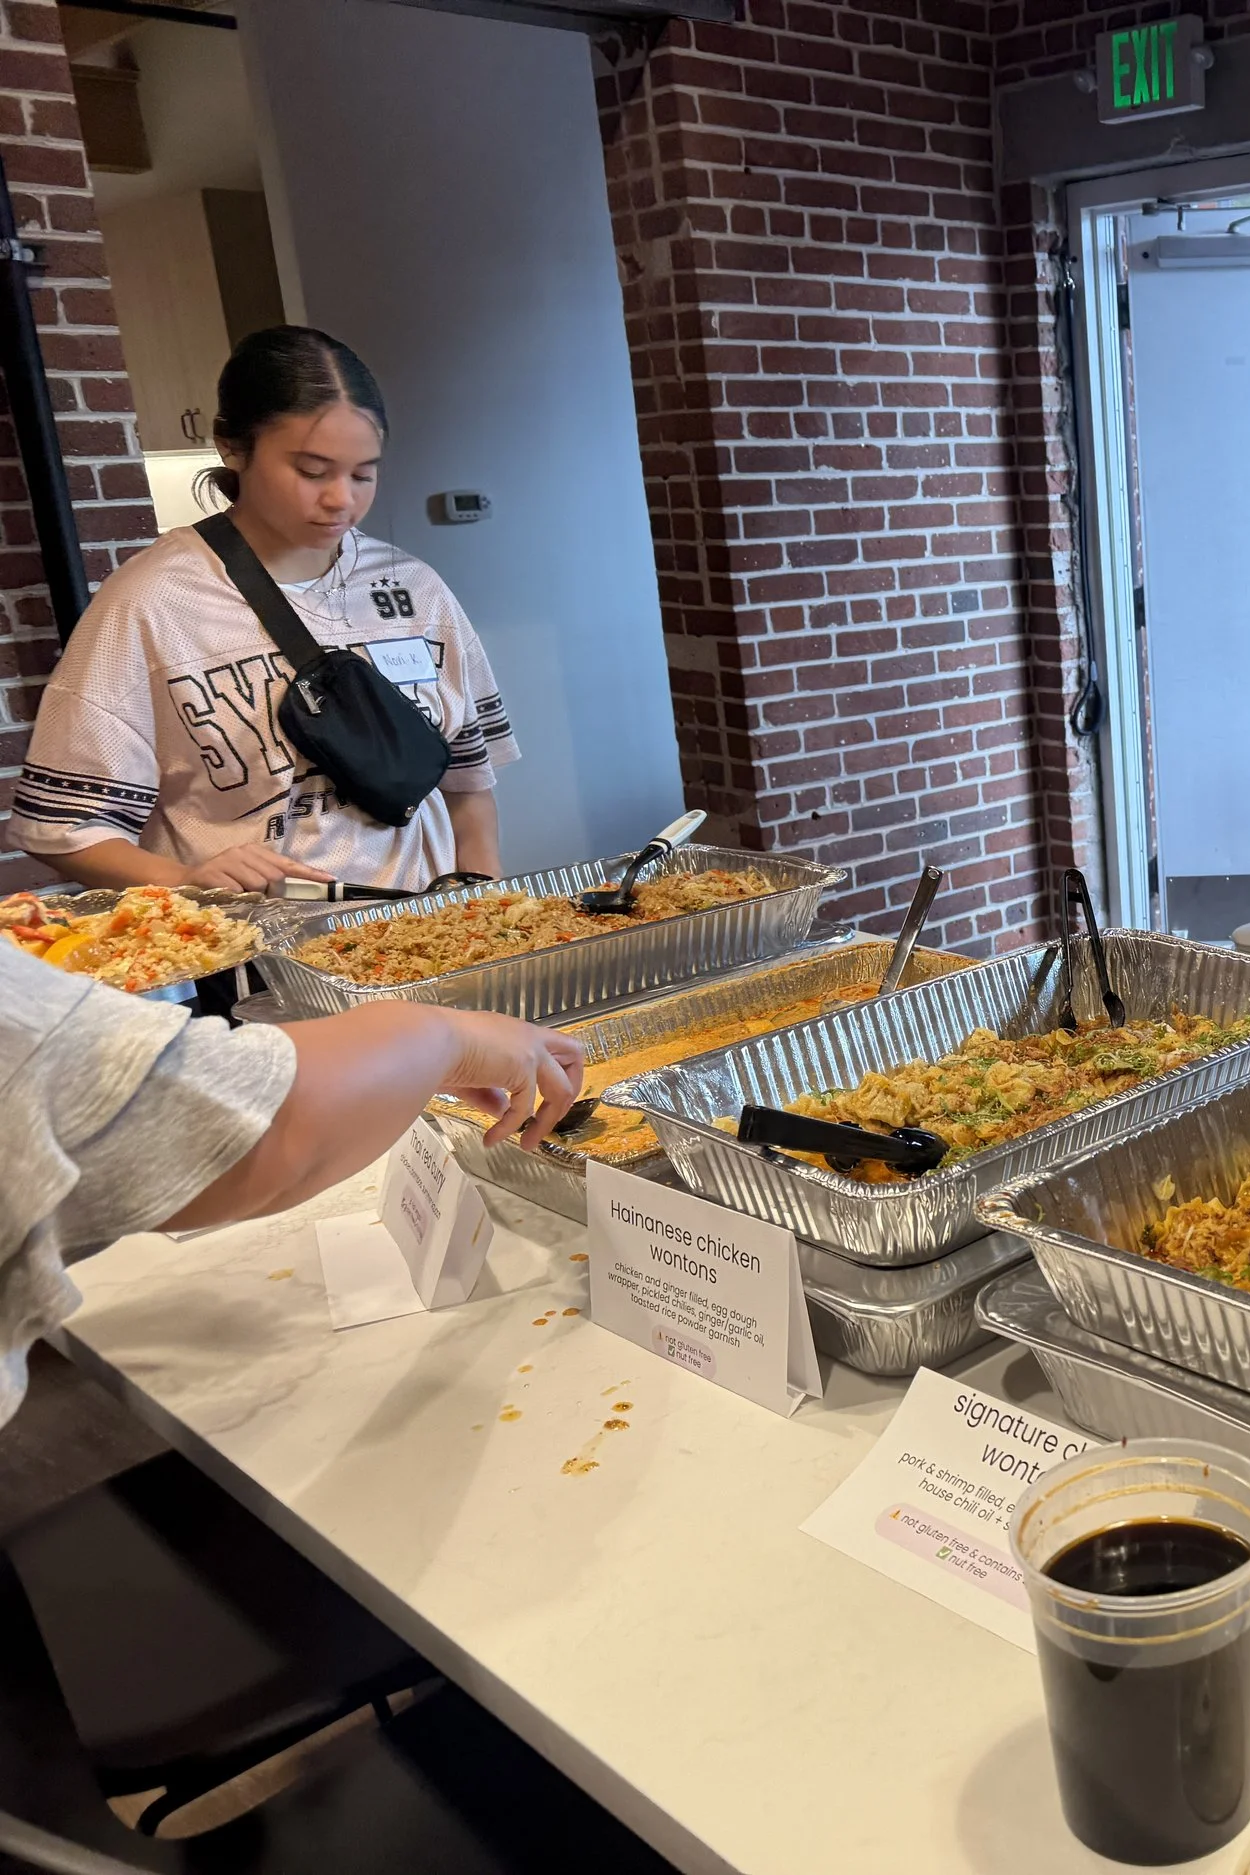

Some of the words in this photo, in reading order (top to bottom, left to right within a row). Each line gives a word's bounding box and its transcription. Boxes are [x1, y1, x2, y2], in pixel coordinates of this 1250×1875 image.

[1112, 21, 1178, 108] EXIT
[370, 588, 416, 621] 98
[421, 1149, 434, 1171] red
[431, 1161, 446, 1195] curry
[611, 1200, 692, 1246] Hainanese
[697, 1234, 761, 1274] chicken
[650, 1244, 718, 1284] wontons
[607, 1271, 641, 1294] wrapper,
[641, 1285, 670, 1304] pickled
[698, 1310, 753, 1341] ginger/garlic
[753, 1333, 766, 1348] oil,
[614, 1262, 644, 1281] chicken
[645, 1275, 661, 1288] and
[662, 1281, 688, 1299] ginger
[689, 1291, 710, 1311] filled,
[711, 1302, 728, 1318] egg
[729, 1309, 757, 1330] dough
[630, 1293, 660, 1313] toasted
[661, 1306, 677, 1320] rice
[677, 1314, 707, 1334] powder
[708, 1329, 741, 1349] garnish
[665, 1334, 676, 1346] not
[677, 1339, 699, 1356] gluten
[698, 1348, 712, 1363] free
[676, 1350, 688, 1363] nut
[688, 1355, 702, 1369] free
[953, 1393, 1058, 1454] signature
[898, 1451, 925, 1471] pork
[925, 1463, 936, 1476] &
[938, 1467, 976, 1495] shrimp
[974, 1485, 1004, 1511] filled,
[981, 1443, 1048, 1485] wont
[918, 1477, 953, 1502] house
[953, 1495, 978, 1515] chili
[977, 1507, 996, 1522] oil
[996, 1516, 1005, 1525] +
[900, 1514, 917, 1529] not
[917, 1521, 949, 1544] gluten
[948, 1537, 970, 1554] free
[968, 1549, 979, 1559] &
[977, 1555, 1024, 1582] contains
[947, 1553, 968, 1570] nut
[966, 1562, 989, 1580] free
